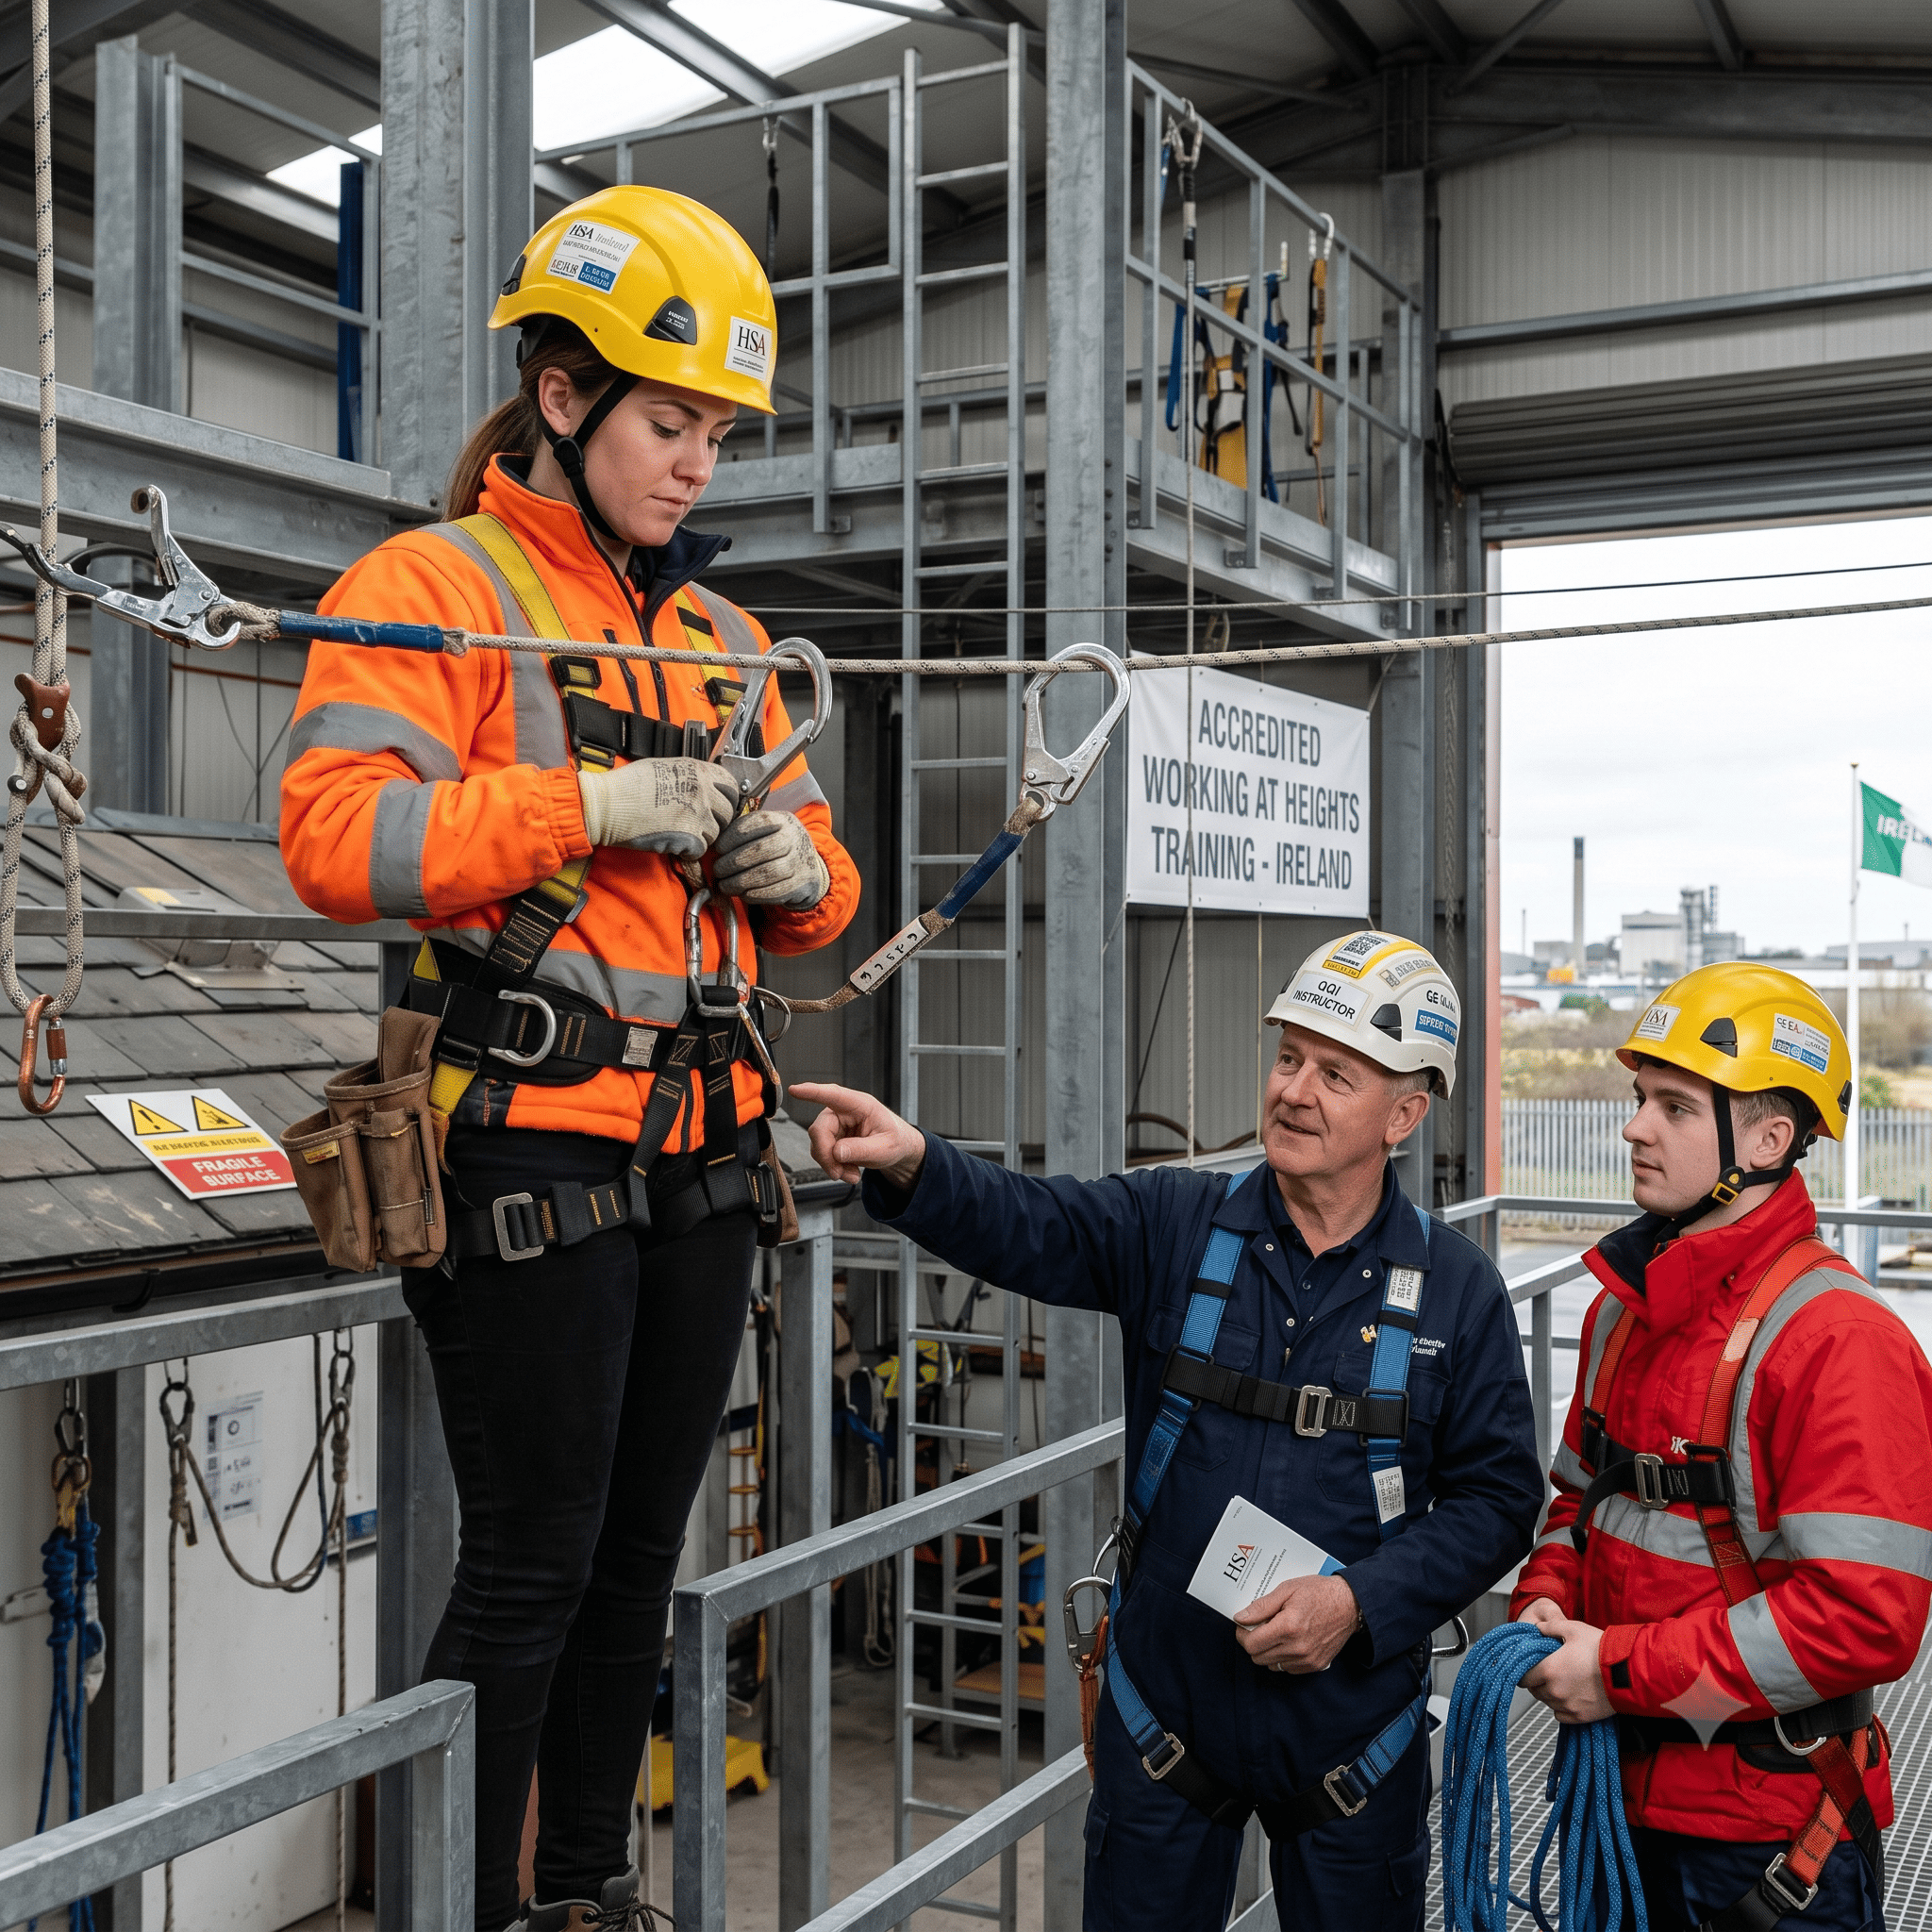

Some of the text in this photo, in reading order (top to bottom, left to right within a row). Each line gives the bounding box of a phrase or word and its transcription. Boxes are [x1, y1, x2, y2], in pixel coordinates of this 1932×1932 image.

[569, 224, 594, 240] HSA
[737, 325, 766, 357] HSA
[1198, 699, 1322, 768] ACCREDITED
[1142, 754, 1360, 834] WORKING AT HEIGHTS
[1151, 824, 1256, 883] TRAINING
[1275, 841, 1353, 891] IRELAND
[1292, 990, 1356, 1020] INSTRUCTOR
[192, 1156, 267, 1174] FRAGILE
[201, 1169, 282, 1188] SURFACE
[1223, 1544, 1256, 1583] HSA
